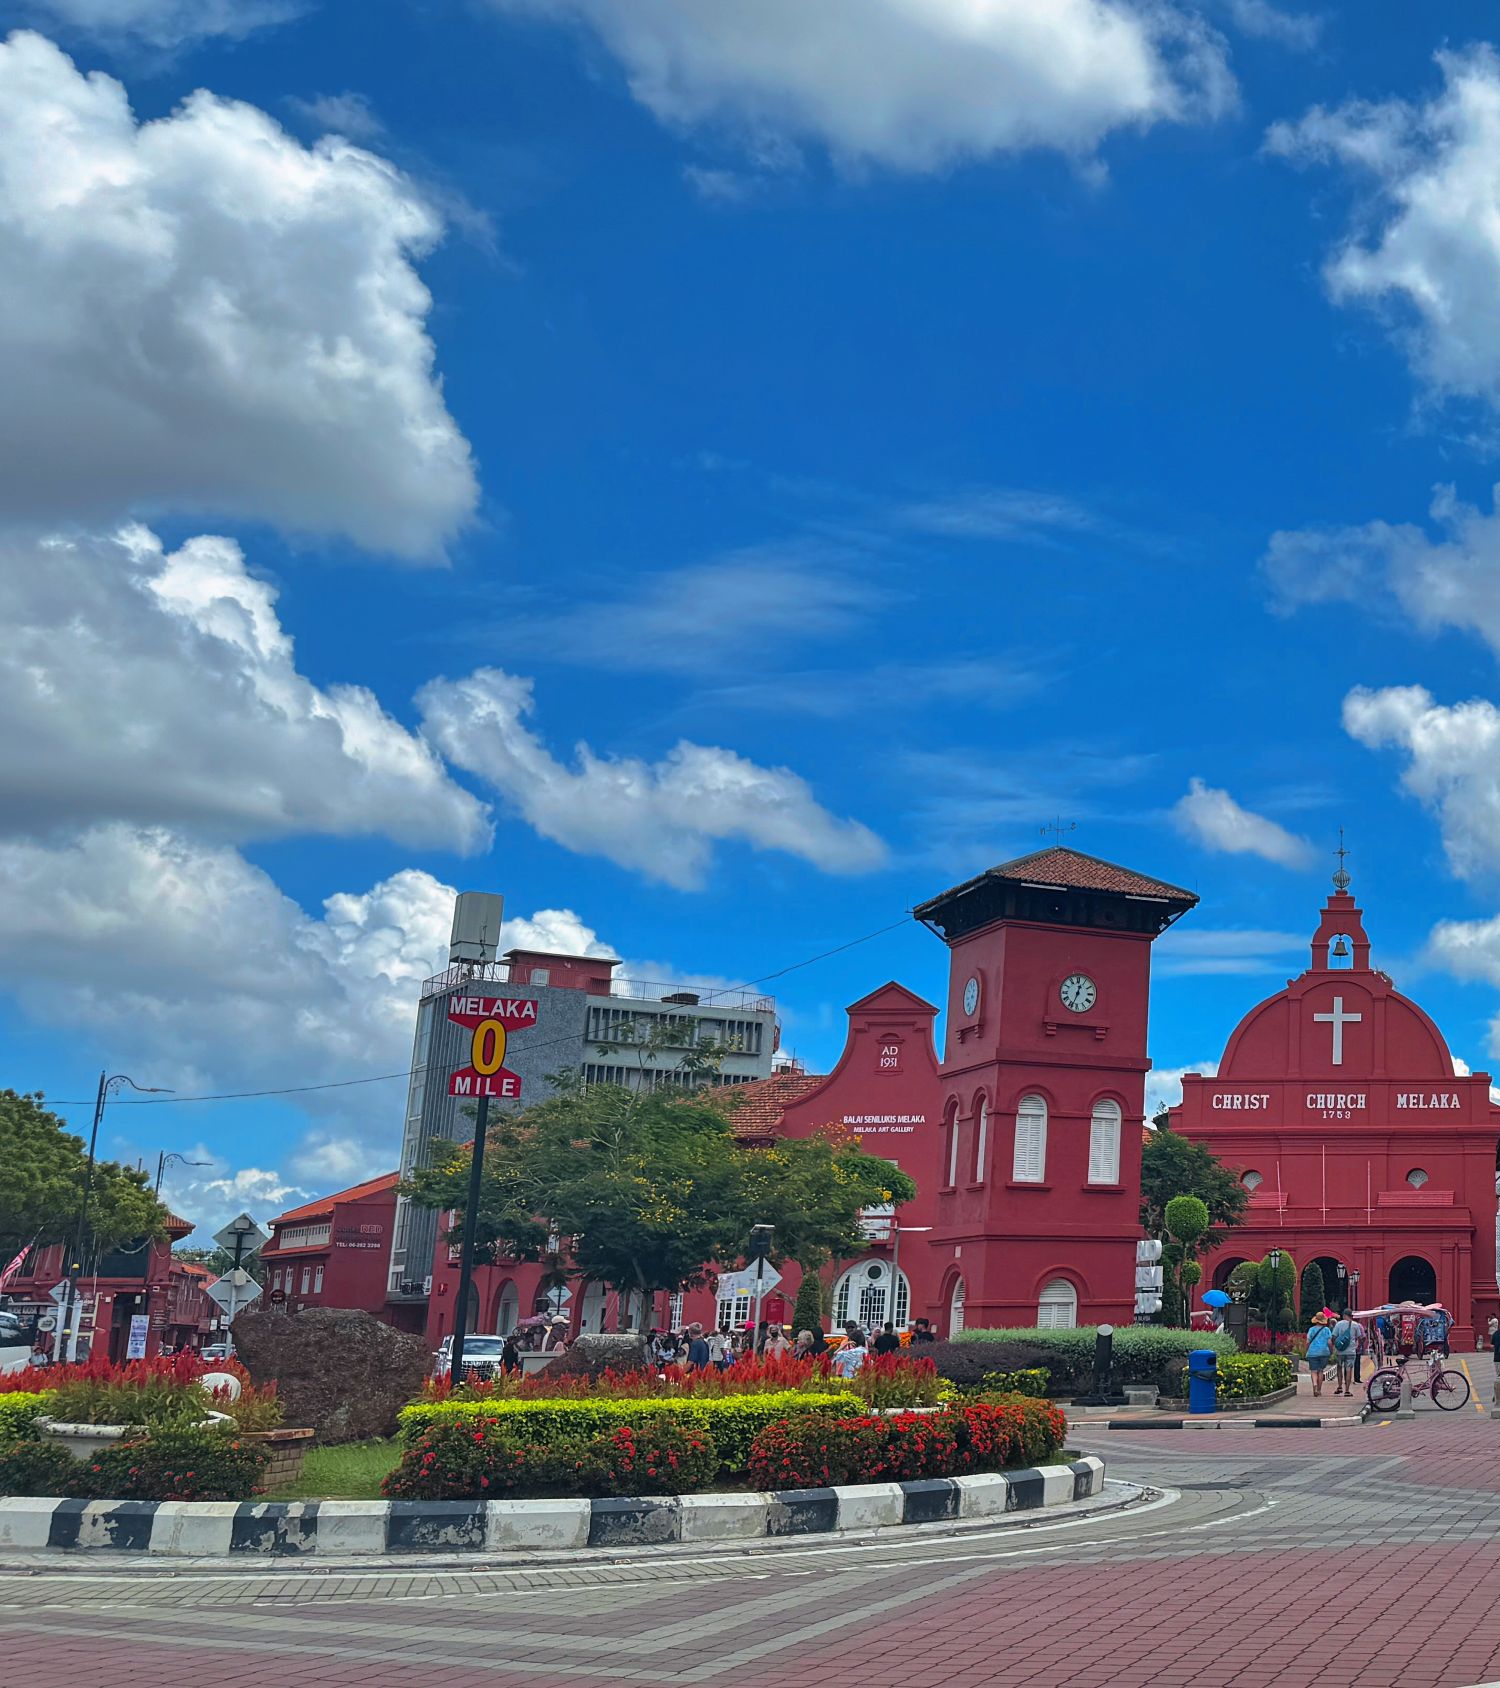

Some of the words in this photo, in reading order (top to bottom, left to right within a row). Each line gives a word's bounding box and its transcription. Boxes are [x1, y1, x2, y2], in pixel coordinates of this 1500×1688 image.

[450, 996, 536, 1019] MELAKA
[471, 1018, 507, 1076] 0
[882, 1046, 898, 1055] AD
[880, 1057, 897, 1067] 1931
[454, 1076, 515, 1097] MILE
[1212, 1094, 1270, 1109] CHRIST
[1306, 1094, 1366, 1109] CHURCH
[1396, 1093, 1461, 1109] MELAKA
[843, 1115, 863, 1124] BALAI
[897, 1115, 925, 1124] MELAKA
[1322, 1110, 1351, 1119] 1753
